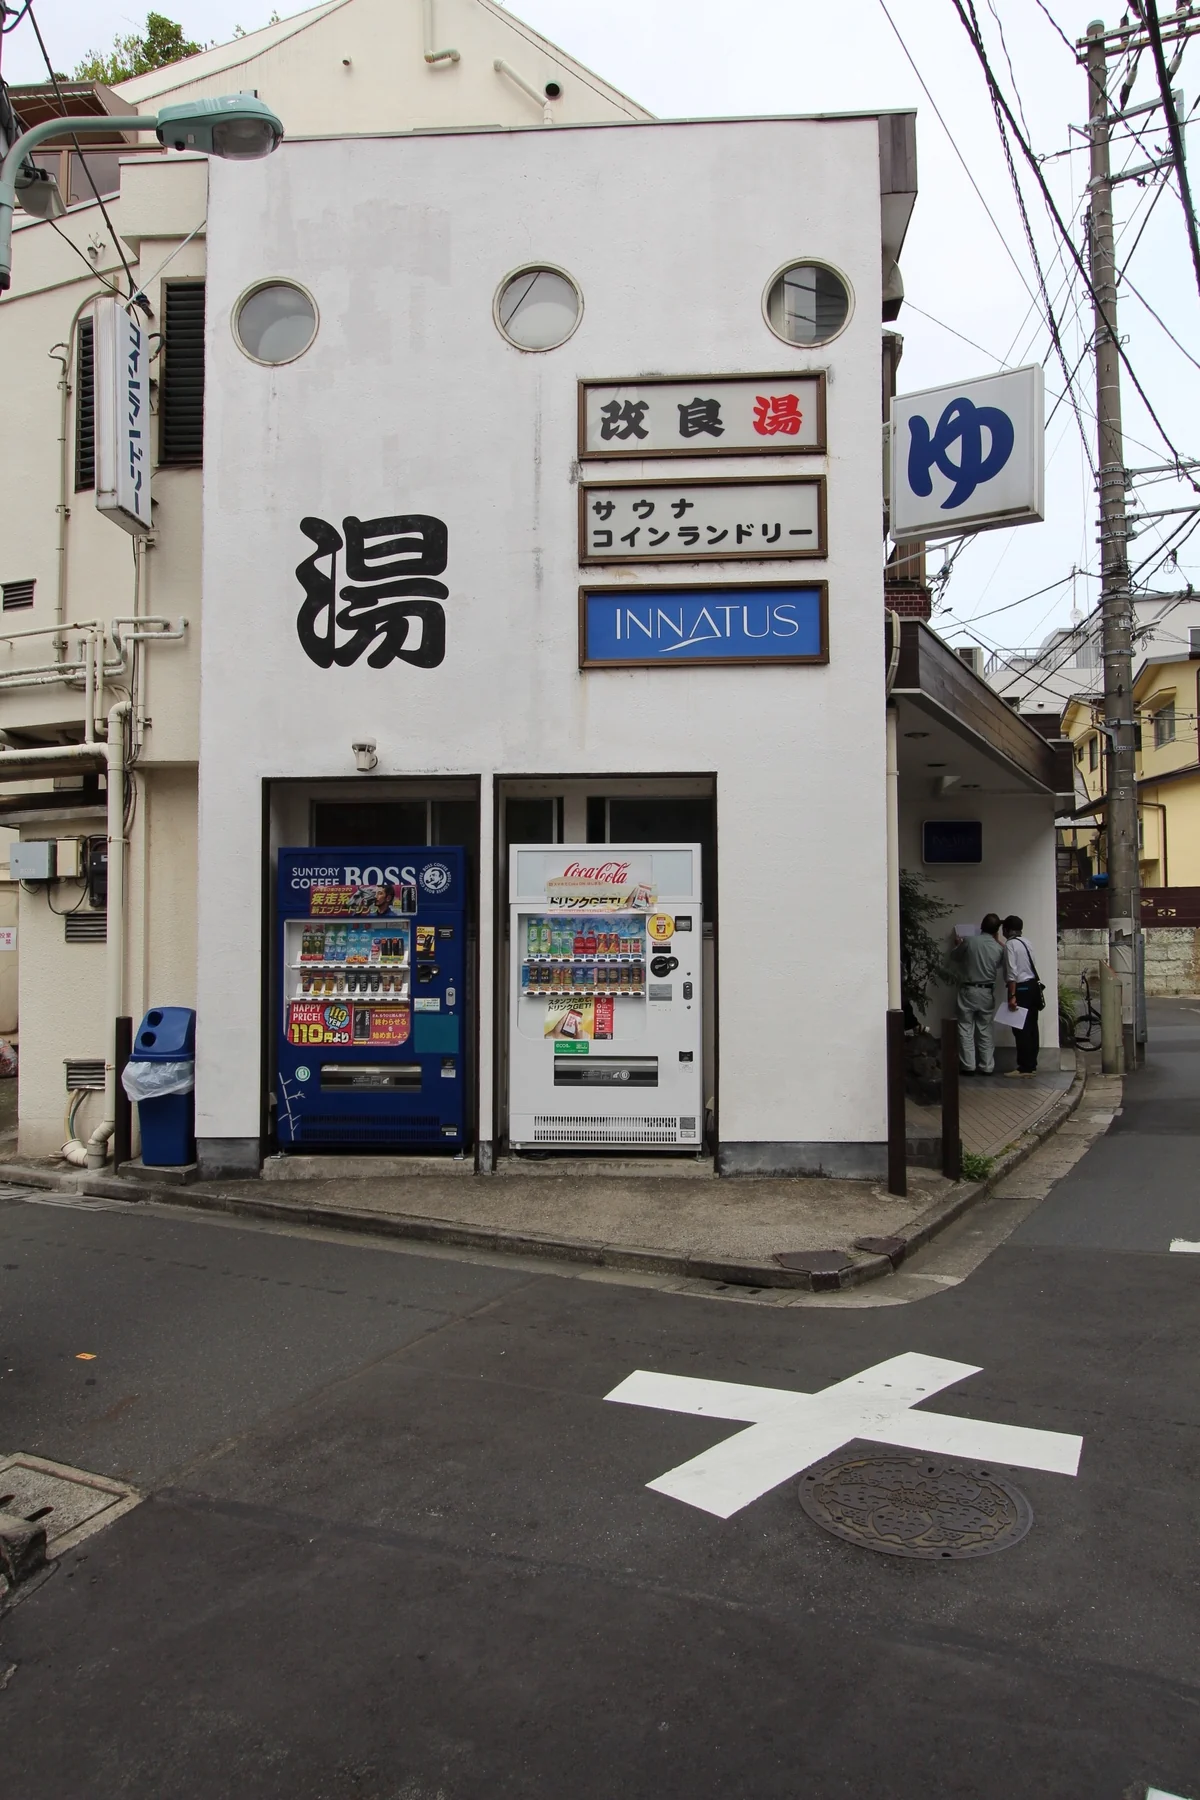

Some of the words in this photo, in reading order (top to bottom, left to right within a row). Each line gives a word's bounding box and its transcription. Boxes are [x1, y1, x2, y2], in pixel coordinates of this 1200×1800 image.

[600, 393, 803, 440] 改良湯
[907, 397, 1014, 509] ゆ
[592, 498, 694, 521] サウナ
[593, 523, 813, 548] コインランドリー
[295, 514, 449, 669] 湯
[616, 605, 799, 652] INNATUS
[292, 867, 340, 877] SUNTORY
[343, 866, 416, 886] BOSS
[293, 1003, 321, 1013] HAPPY
[293, 1013, 321, 1022] PRICE!
[328, 1005, 348, 1021] 110
[328, 1018, 342, 1027] YEN
